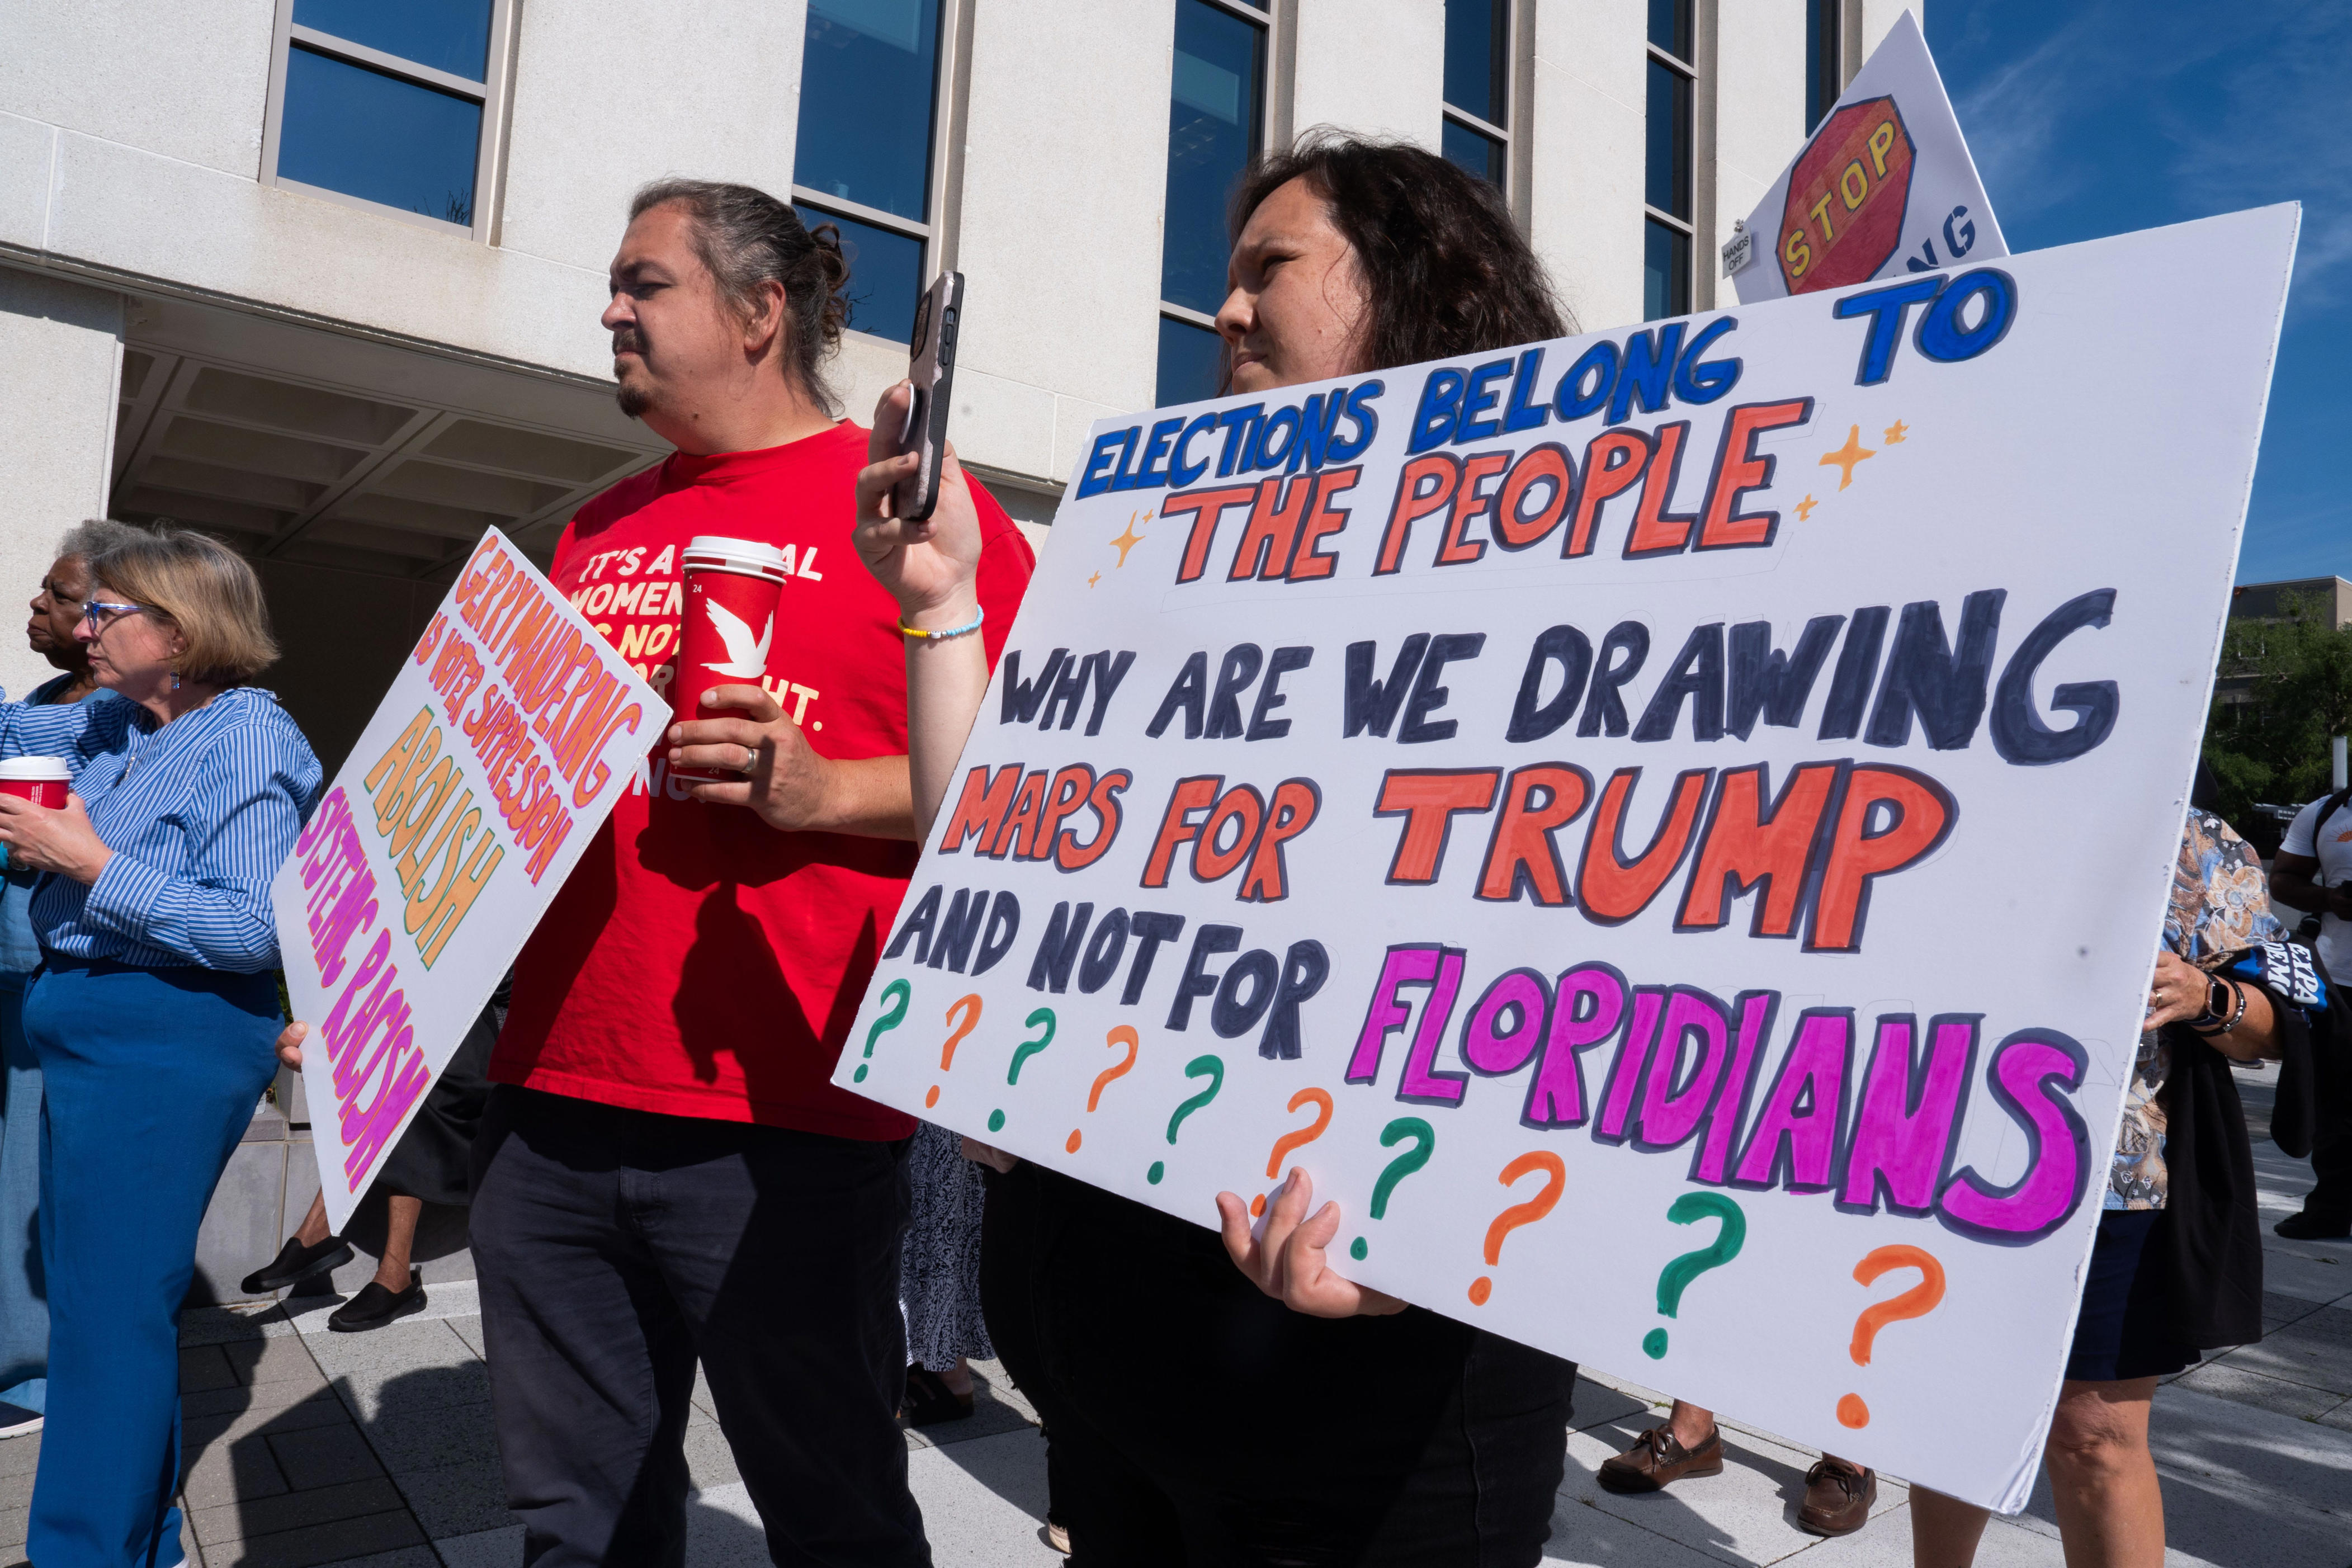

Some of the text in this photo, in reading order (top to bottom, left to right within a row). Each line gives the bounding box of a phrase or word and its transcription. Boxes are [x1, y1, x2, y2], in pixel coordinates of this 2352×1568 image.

[1723, 235, 1749, 262] HANDS
[1728, 252, 1744, 271] OFF
[1785, 119, 1896, 277] STOP
[1893, 205, 1976, 275] NG
[1075, 266, 2018, 500] ELECTIONS BELONG TO
[579, 546, 647, 583] IT'S
[645, 544, 676, 575] A
[1160, 396, 1815, 584] THE PEOPLE
[456, 535, 643, 810] GERRYMANDERING
[570, 582, 683, 616] MOMEN
[693, 584, 702, 593] 24
[1000, 587, 2119, 766] WHY ARE WE DRAWING
[363, 704, 505, 972] ABOLISH
[413, 611, 574, 887] IS VOTER SUPPRESSION
[938, 758, 1960, 954] MAPS FOR TRUMP
[296, 786, 431, 1194] SYSTEMIC RACISM
[2287, 942, 2319, 1004] EXPA
[882, 884, 2091, 1248] AND NOT FOR FLORIDIANS
